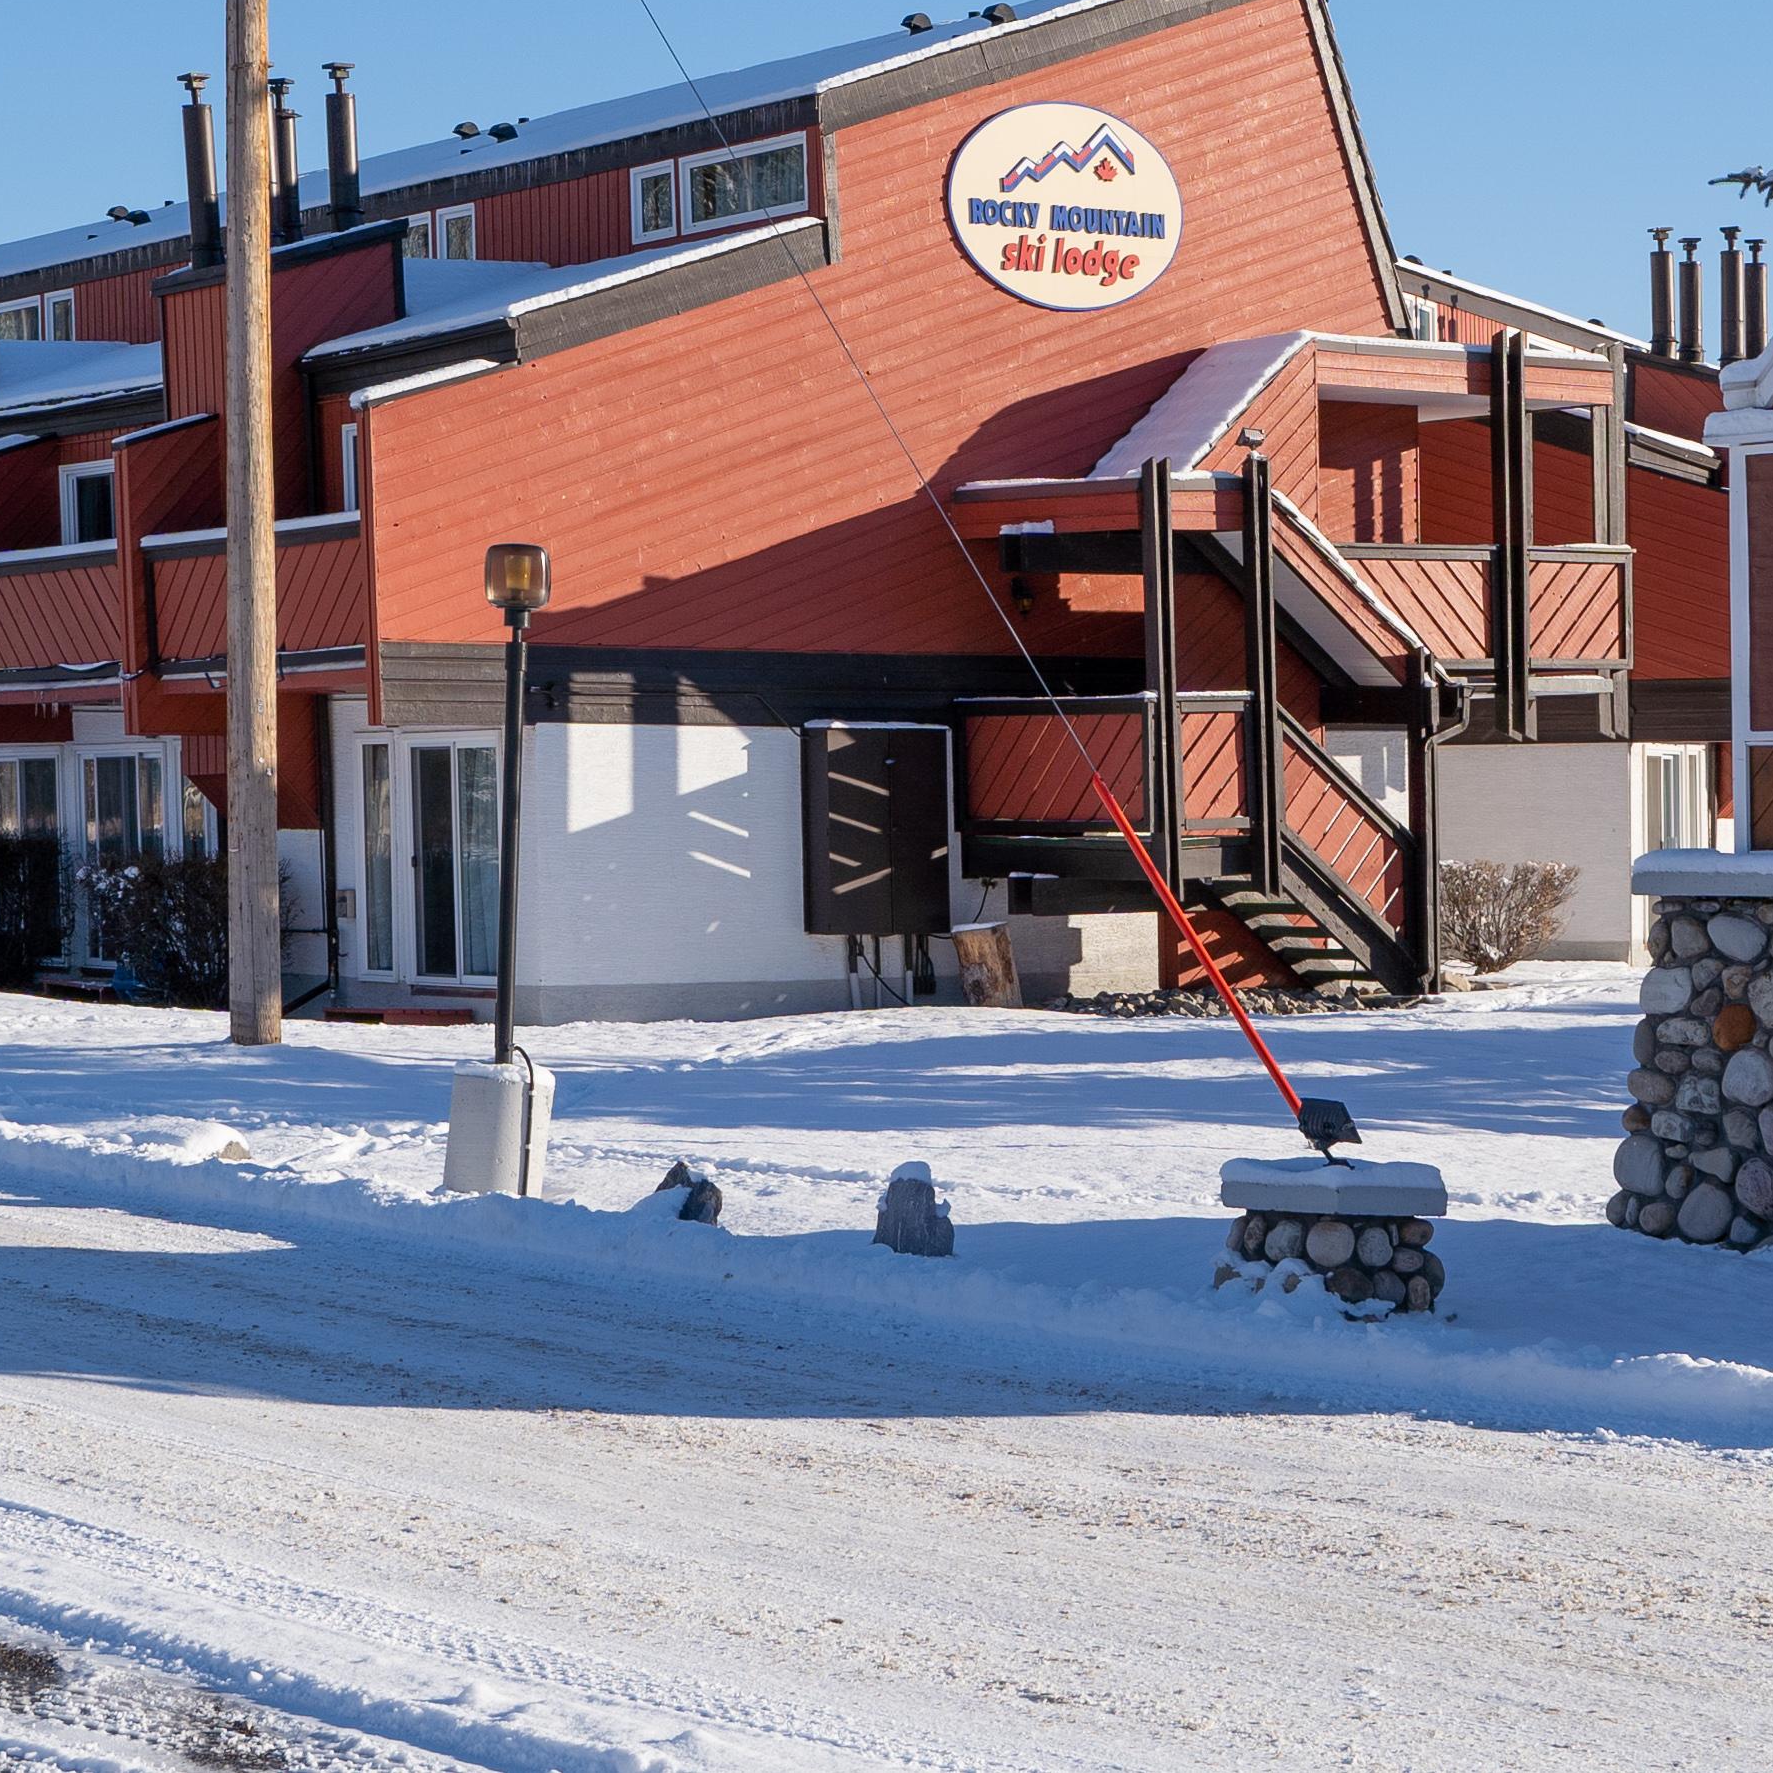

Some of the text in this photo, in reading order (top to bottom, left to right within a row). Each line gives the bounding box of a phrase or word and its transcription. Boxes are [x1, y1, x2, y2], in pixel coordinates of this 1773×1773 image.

[968, 198, 1165, 239] ROCKY MOUNTAIN
[1000, 234, 1140, 286] ski lodge
